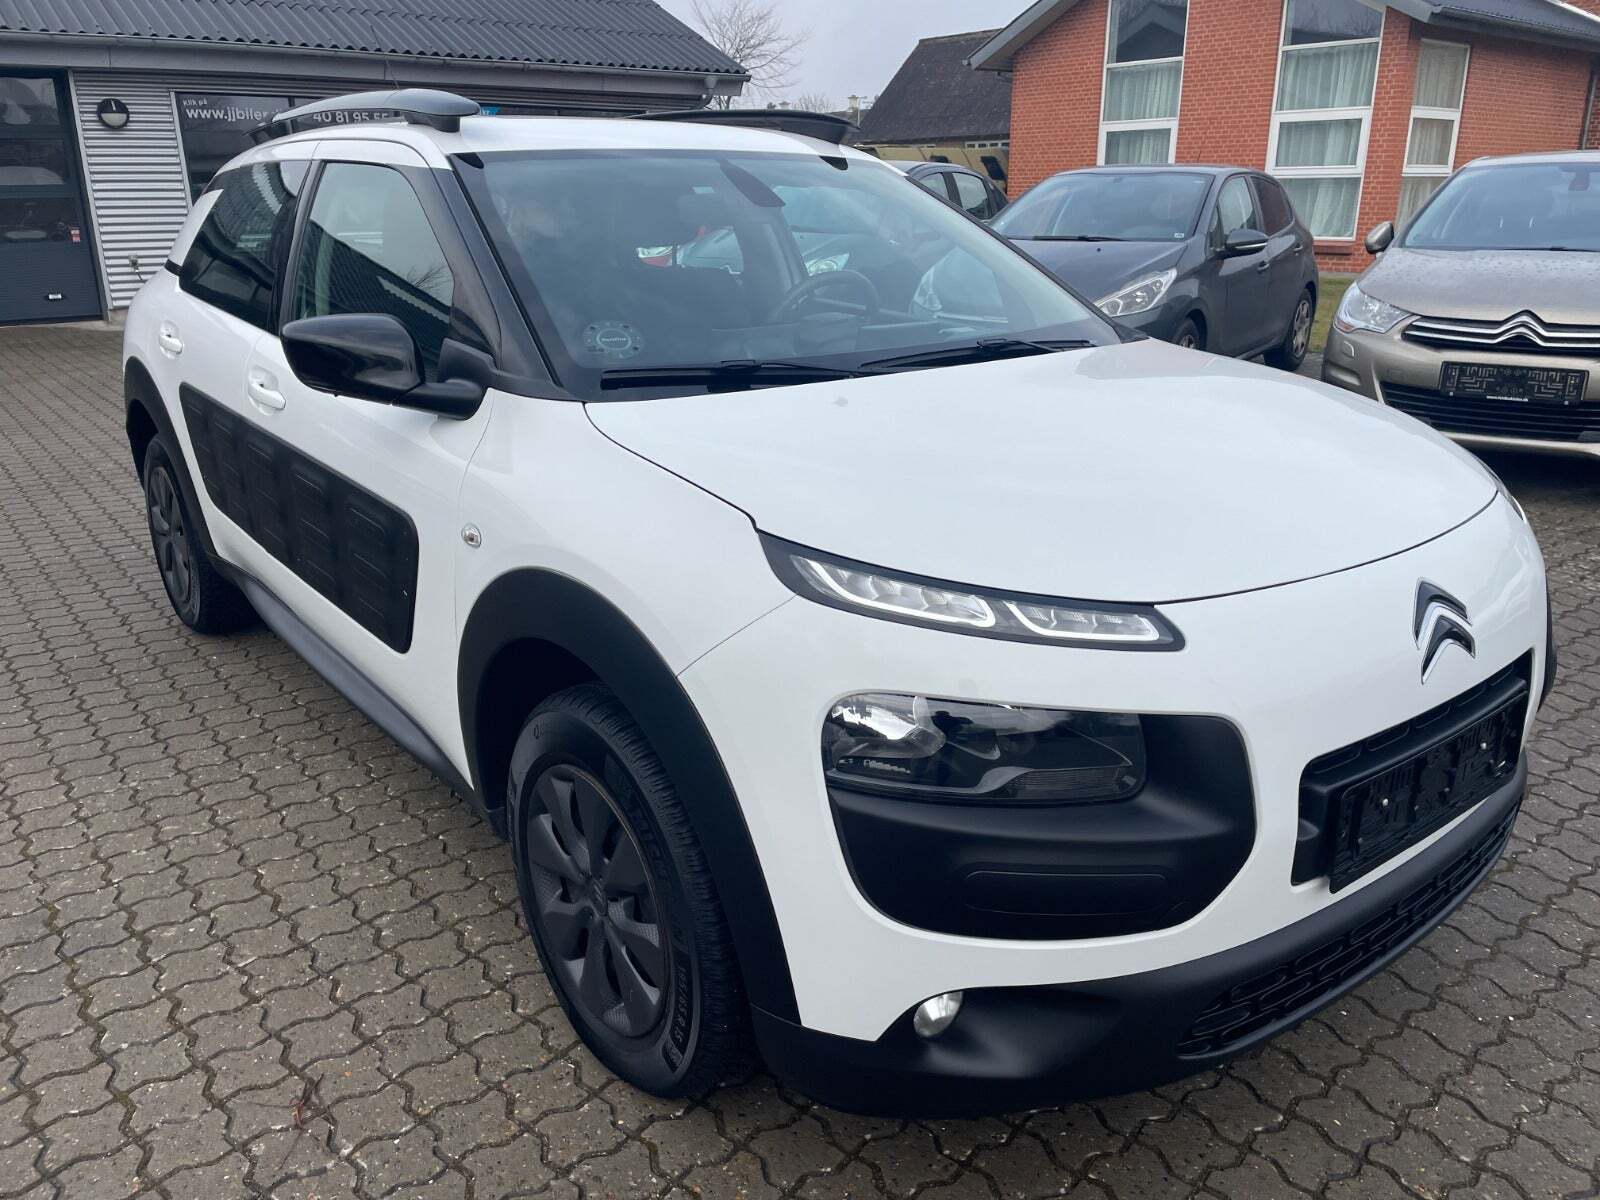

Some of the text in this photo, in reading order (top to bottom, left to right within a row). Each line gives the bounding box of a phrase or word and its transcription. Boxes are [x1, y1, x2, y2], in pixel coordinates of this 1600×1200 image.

[313, 111, 332, 122] 40
[336, 111, 350, 123] 81
[353, 111, 370, 122] 95
